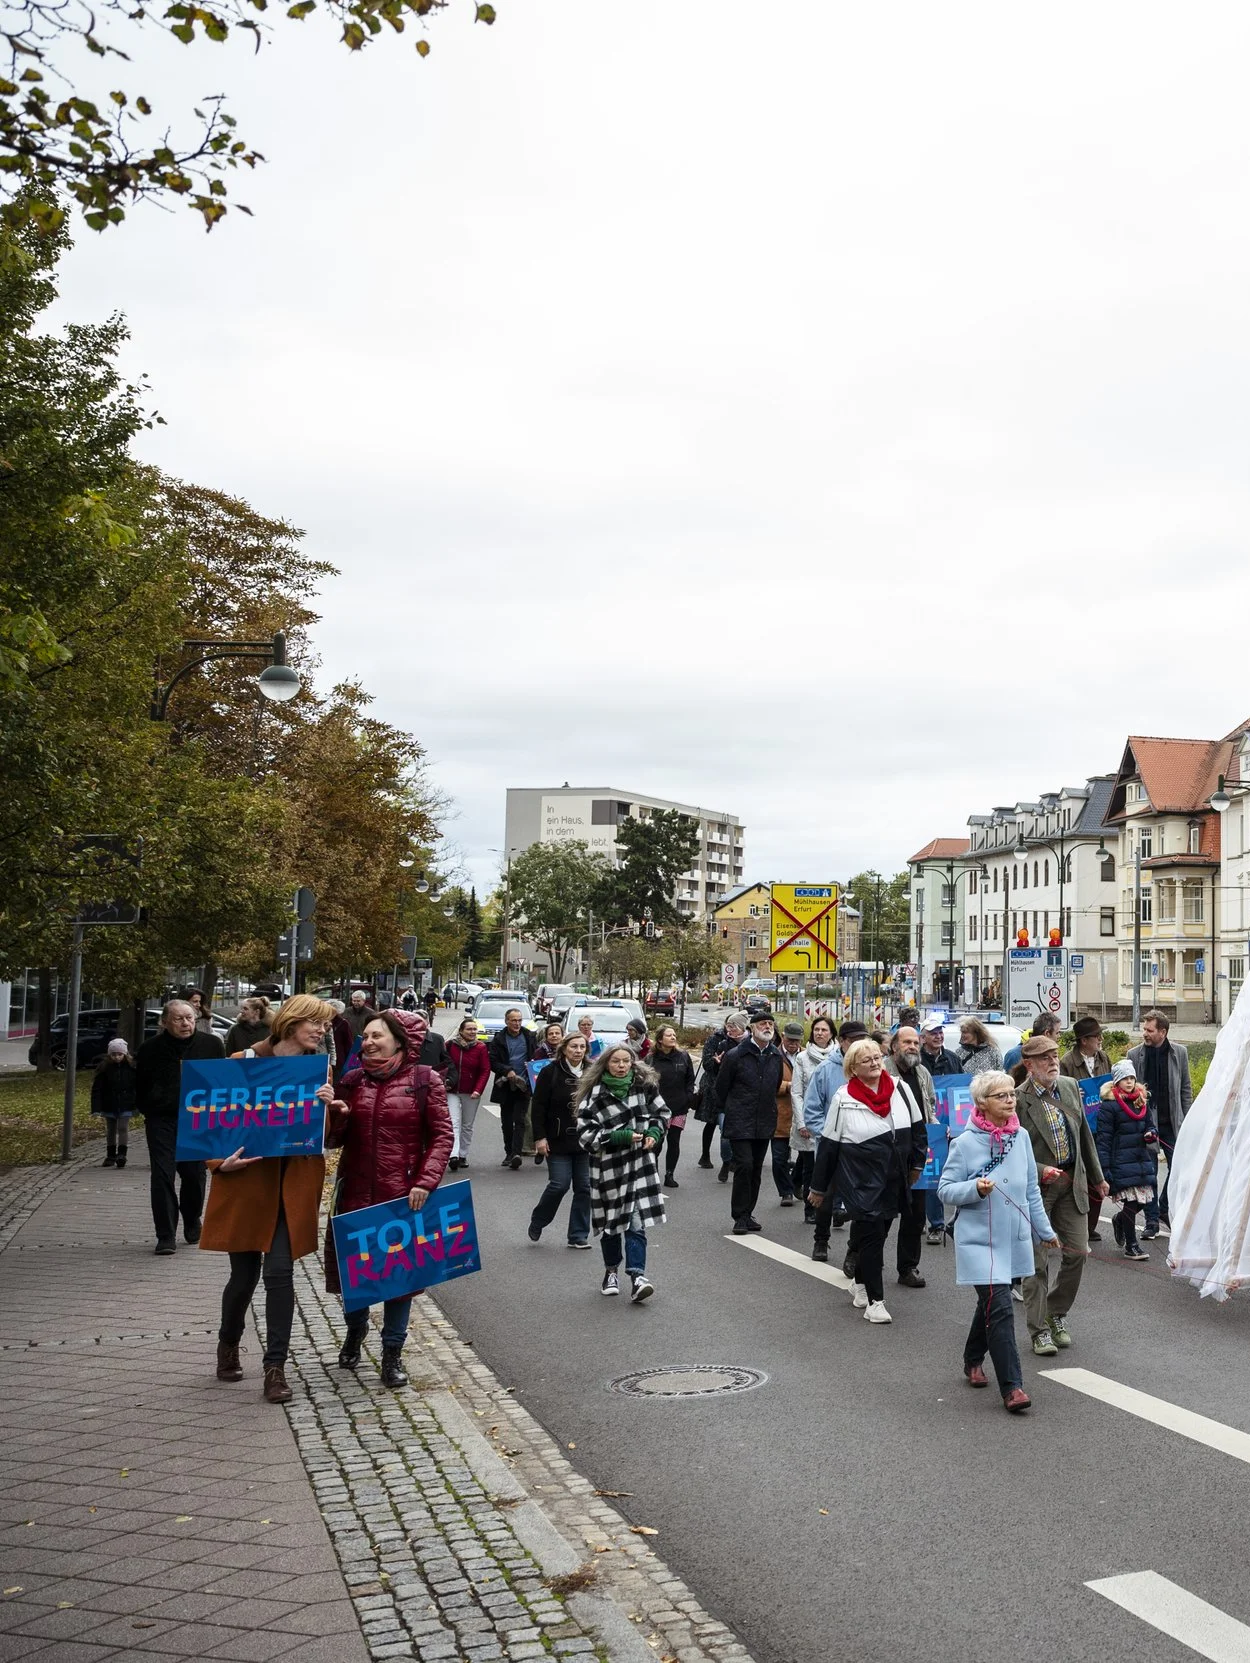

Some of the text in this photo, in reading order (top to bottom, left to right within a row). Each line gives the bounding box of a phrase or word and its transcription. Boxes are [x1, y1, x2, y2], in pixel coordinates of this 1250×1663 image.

[547, 816, 559, 825] ein
[547, 827, 575, 835] in dem
[185, 1084, 320, 1113] GERECH
[188, 1100, 319, 1130] TIGKEIT
[347, 1202, 464, 1261] TOLE
[346, 1222, 473, 1288] RANZ
